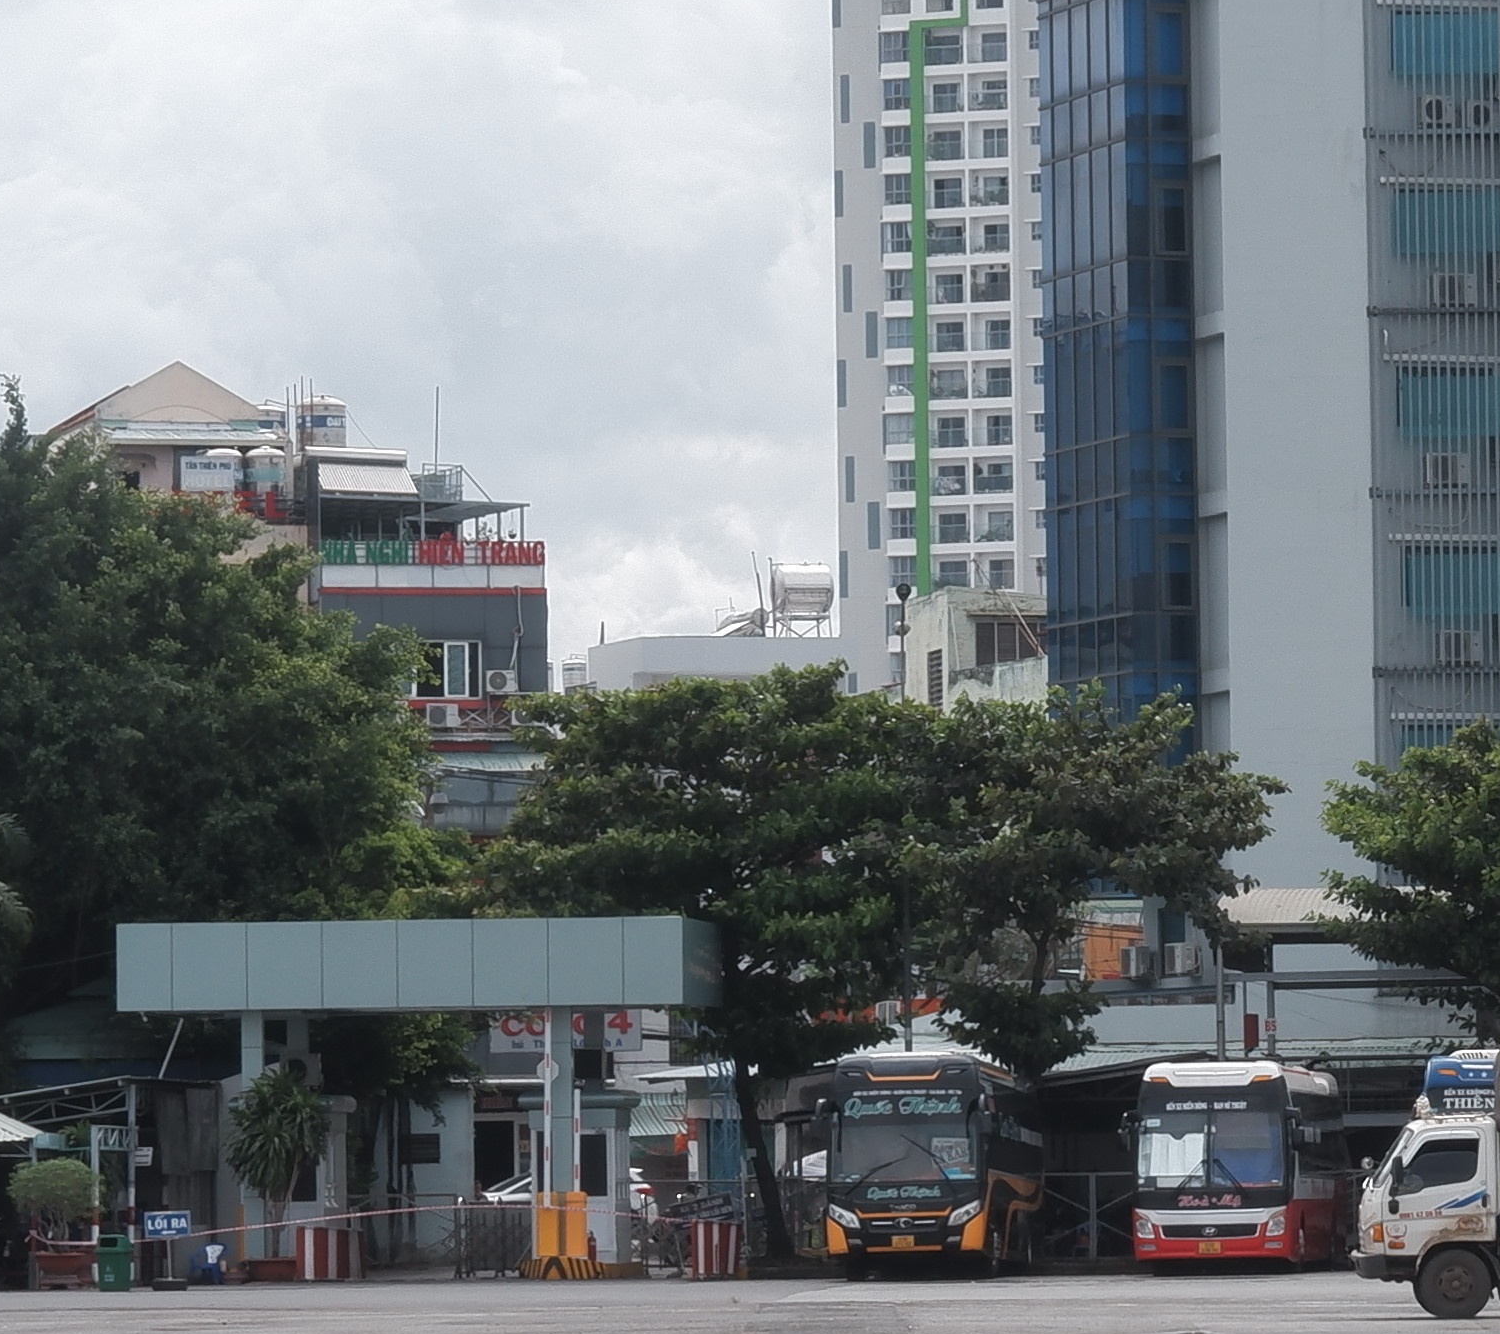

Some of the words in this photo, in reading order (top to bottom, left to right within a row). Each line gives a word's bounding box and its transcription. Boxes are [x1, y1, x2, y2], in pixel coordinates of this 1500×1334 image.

[479, 540, 545, 564] TRANG
[607, 1010, 633, 1035] 4
[1443, 1094, 1495, 1109] THIÊN
[147, 1216, 167, 1230] LỐI
[171, 1217, 188, 1229] RA
